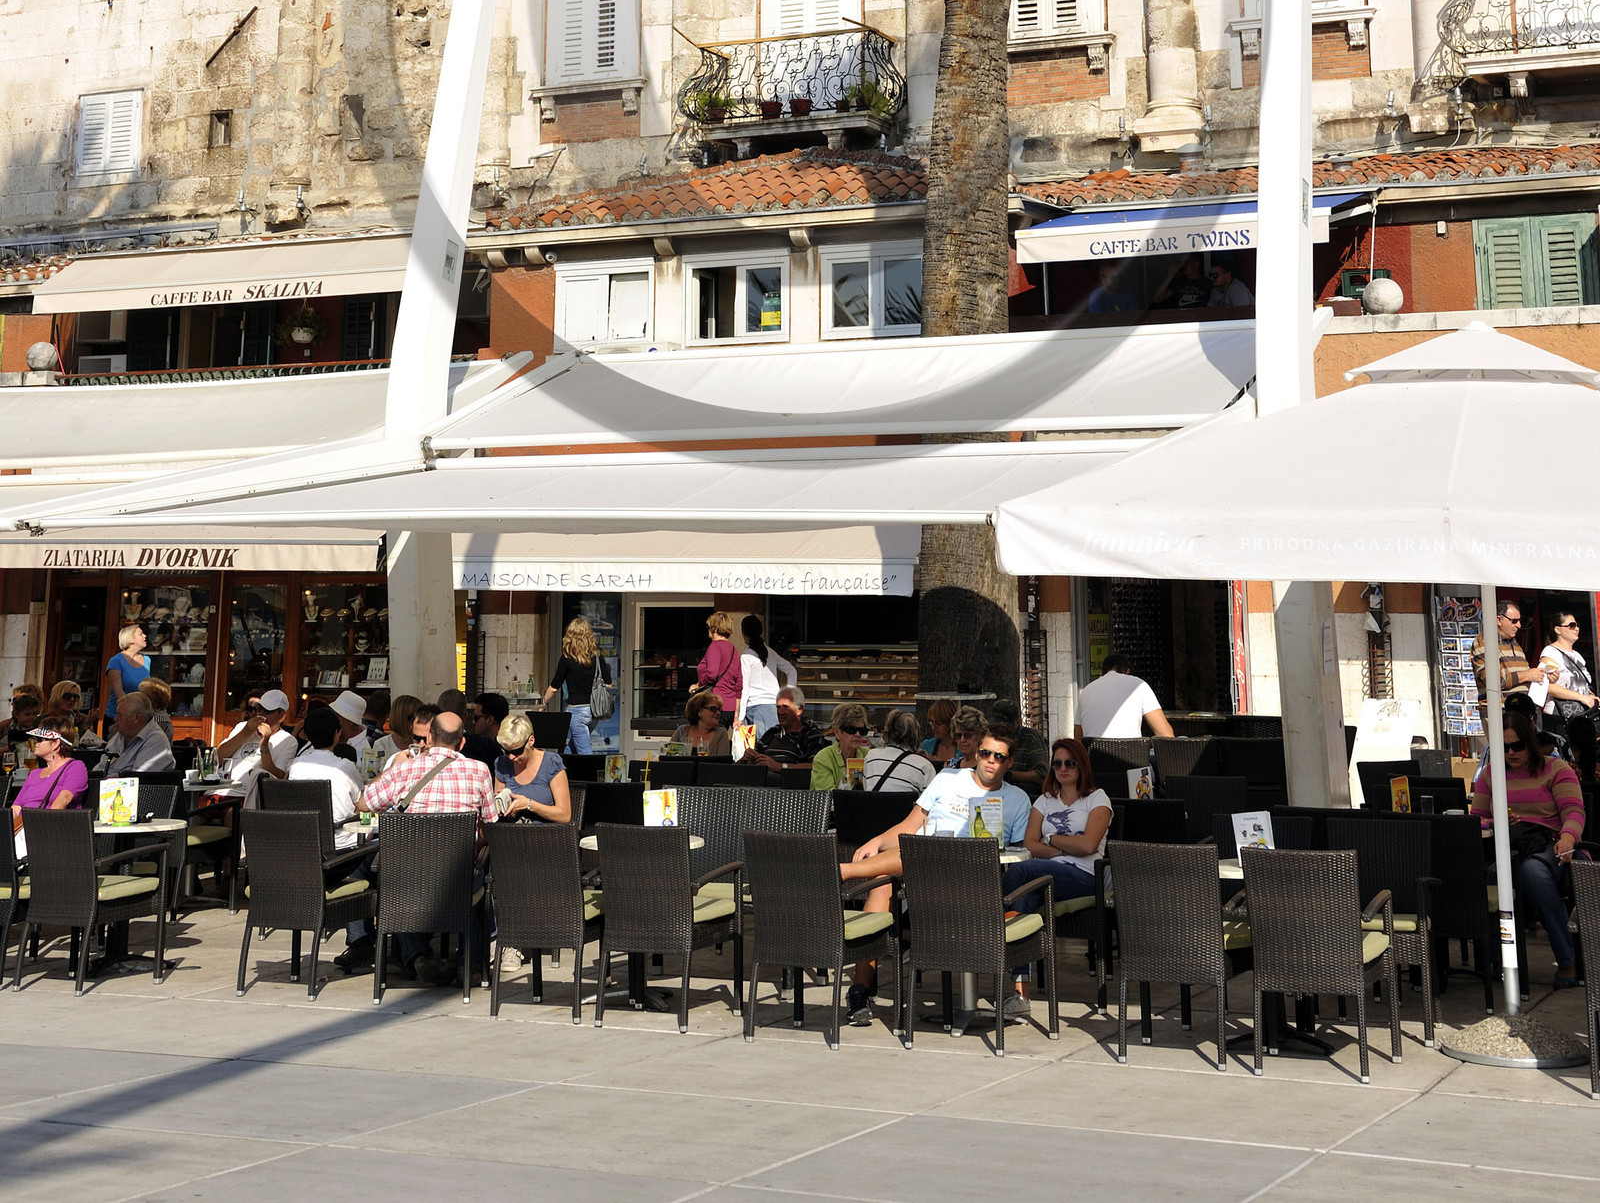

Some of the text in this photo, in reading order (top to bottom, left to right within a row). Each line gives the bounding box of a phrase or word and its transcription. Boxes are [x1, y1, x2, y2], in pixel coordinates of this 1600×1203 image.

[1089, 229, 1251, 256] CAFFE BAR TWINS
[150, 280, 324, 306] CAFFE BAR SKALINA
[43, 548, 239, 568] ZLATARIJA DVORNIK
[1239, 536, 1598, 561] PRIRODNA GAZIRANA MINERALNA
[461, 573, 653, 588] MAISON DE SARAH
